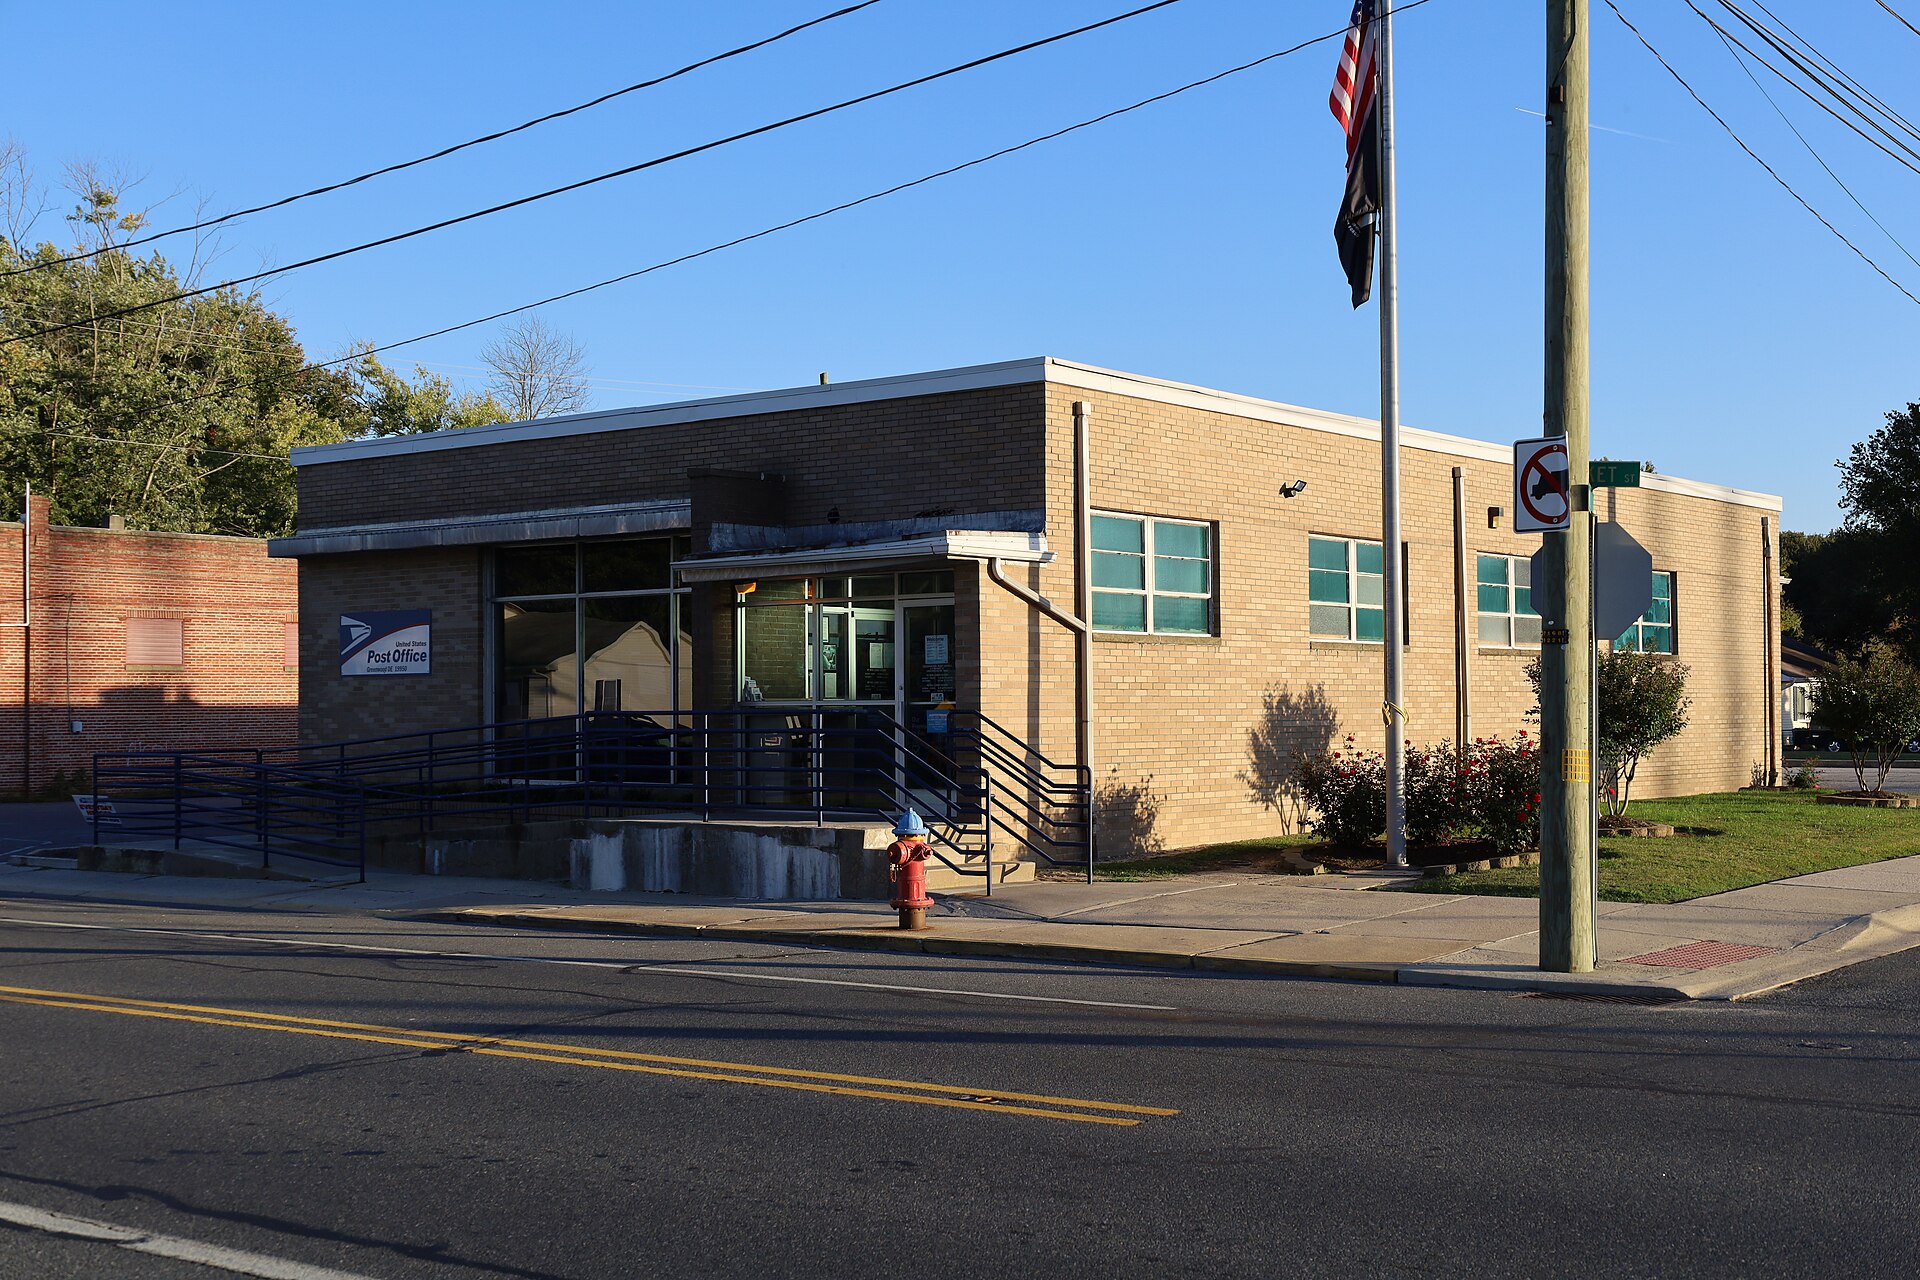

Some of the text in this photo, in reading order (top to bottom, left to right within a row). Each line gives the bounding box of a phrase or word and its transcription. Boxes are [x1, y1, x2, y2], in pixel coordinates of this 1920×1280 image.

[1624, 473, 1635, 483] ST
[367, 649, 427, 663] Post Office
